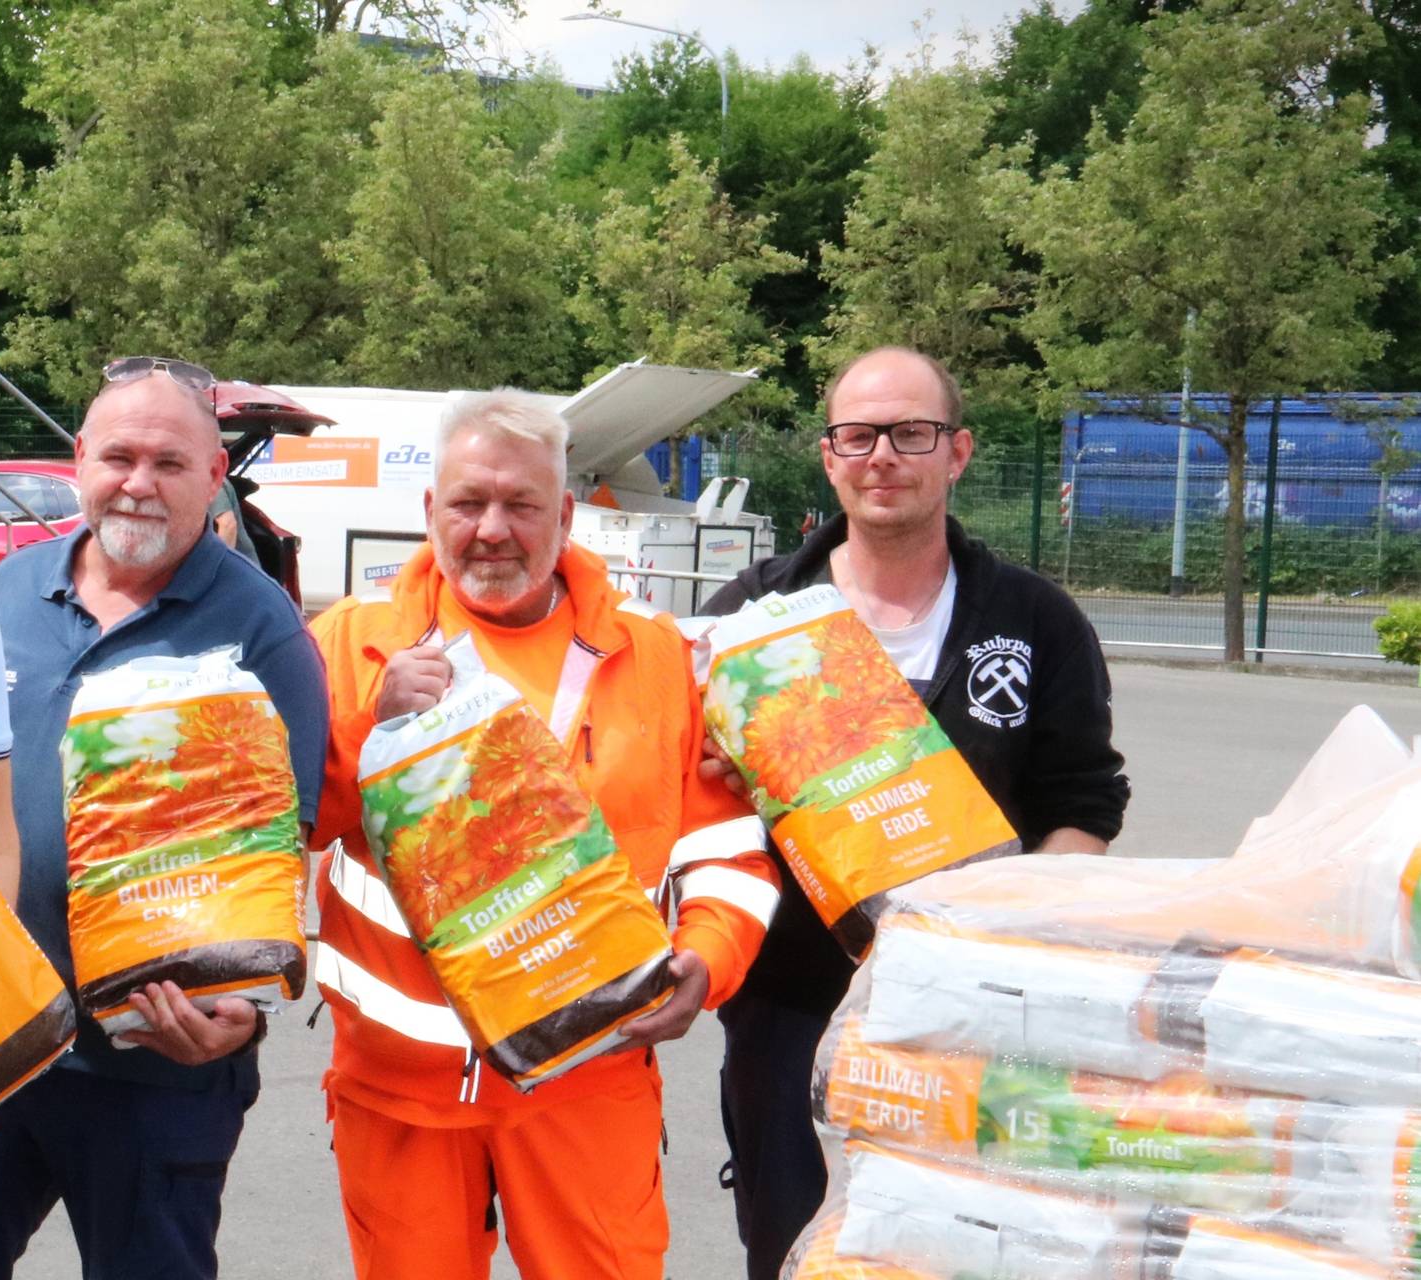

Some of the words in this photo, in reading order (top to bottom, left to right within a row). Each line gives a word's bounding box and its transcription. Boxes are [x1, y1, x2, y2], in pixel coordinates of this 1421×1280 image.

[384, 444, 433, 465] e3e
[823, 750, 898, 799] Torffrei
[848, 779, 933, 824] BLUMEN-
[881, 807, 932, 840] ERDE
[459, 870, 546, 934] Torffrei
[485, 897, 583, 960] BLUMEN-
[517, 929, 579, 974] ERDE
[848, 1056, 953, 1103] BLUMEN-
[865, 1099, 925, 1135] ERDE
